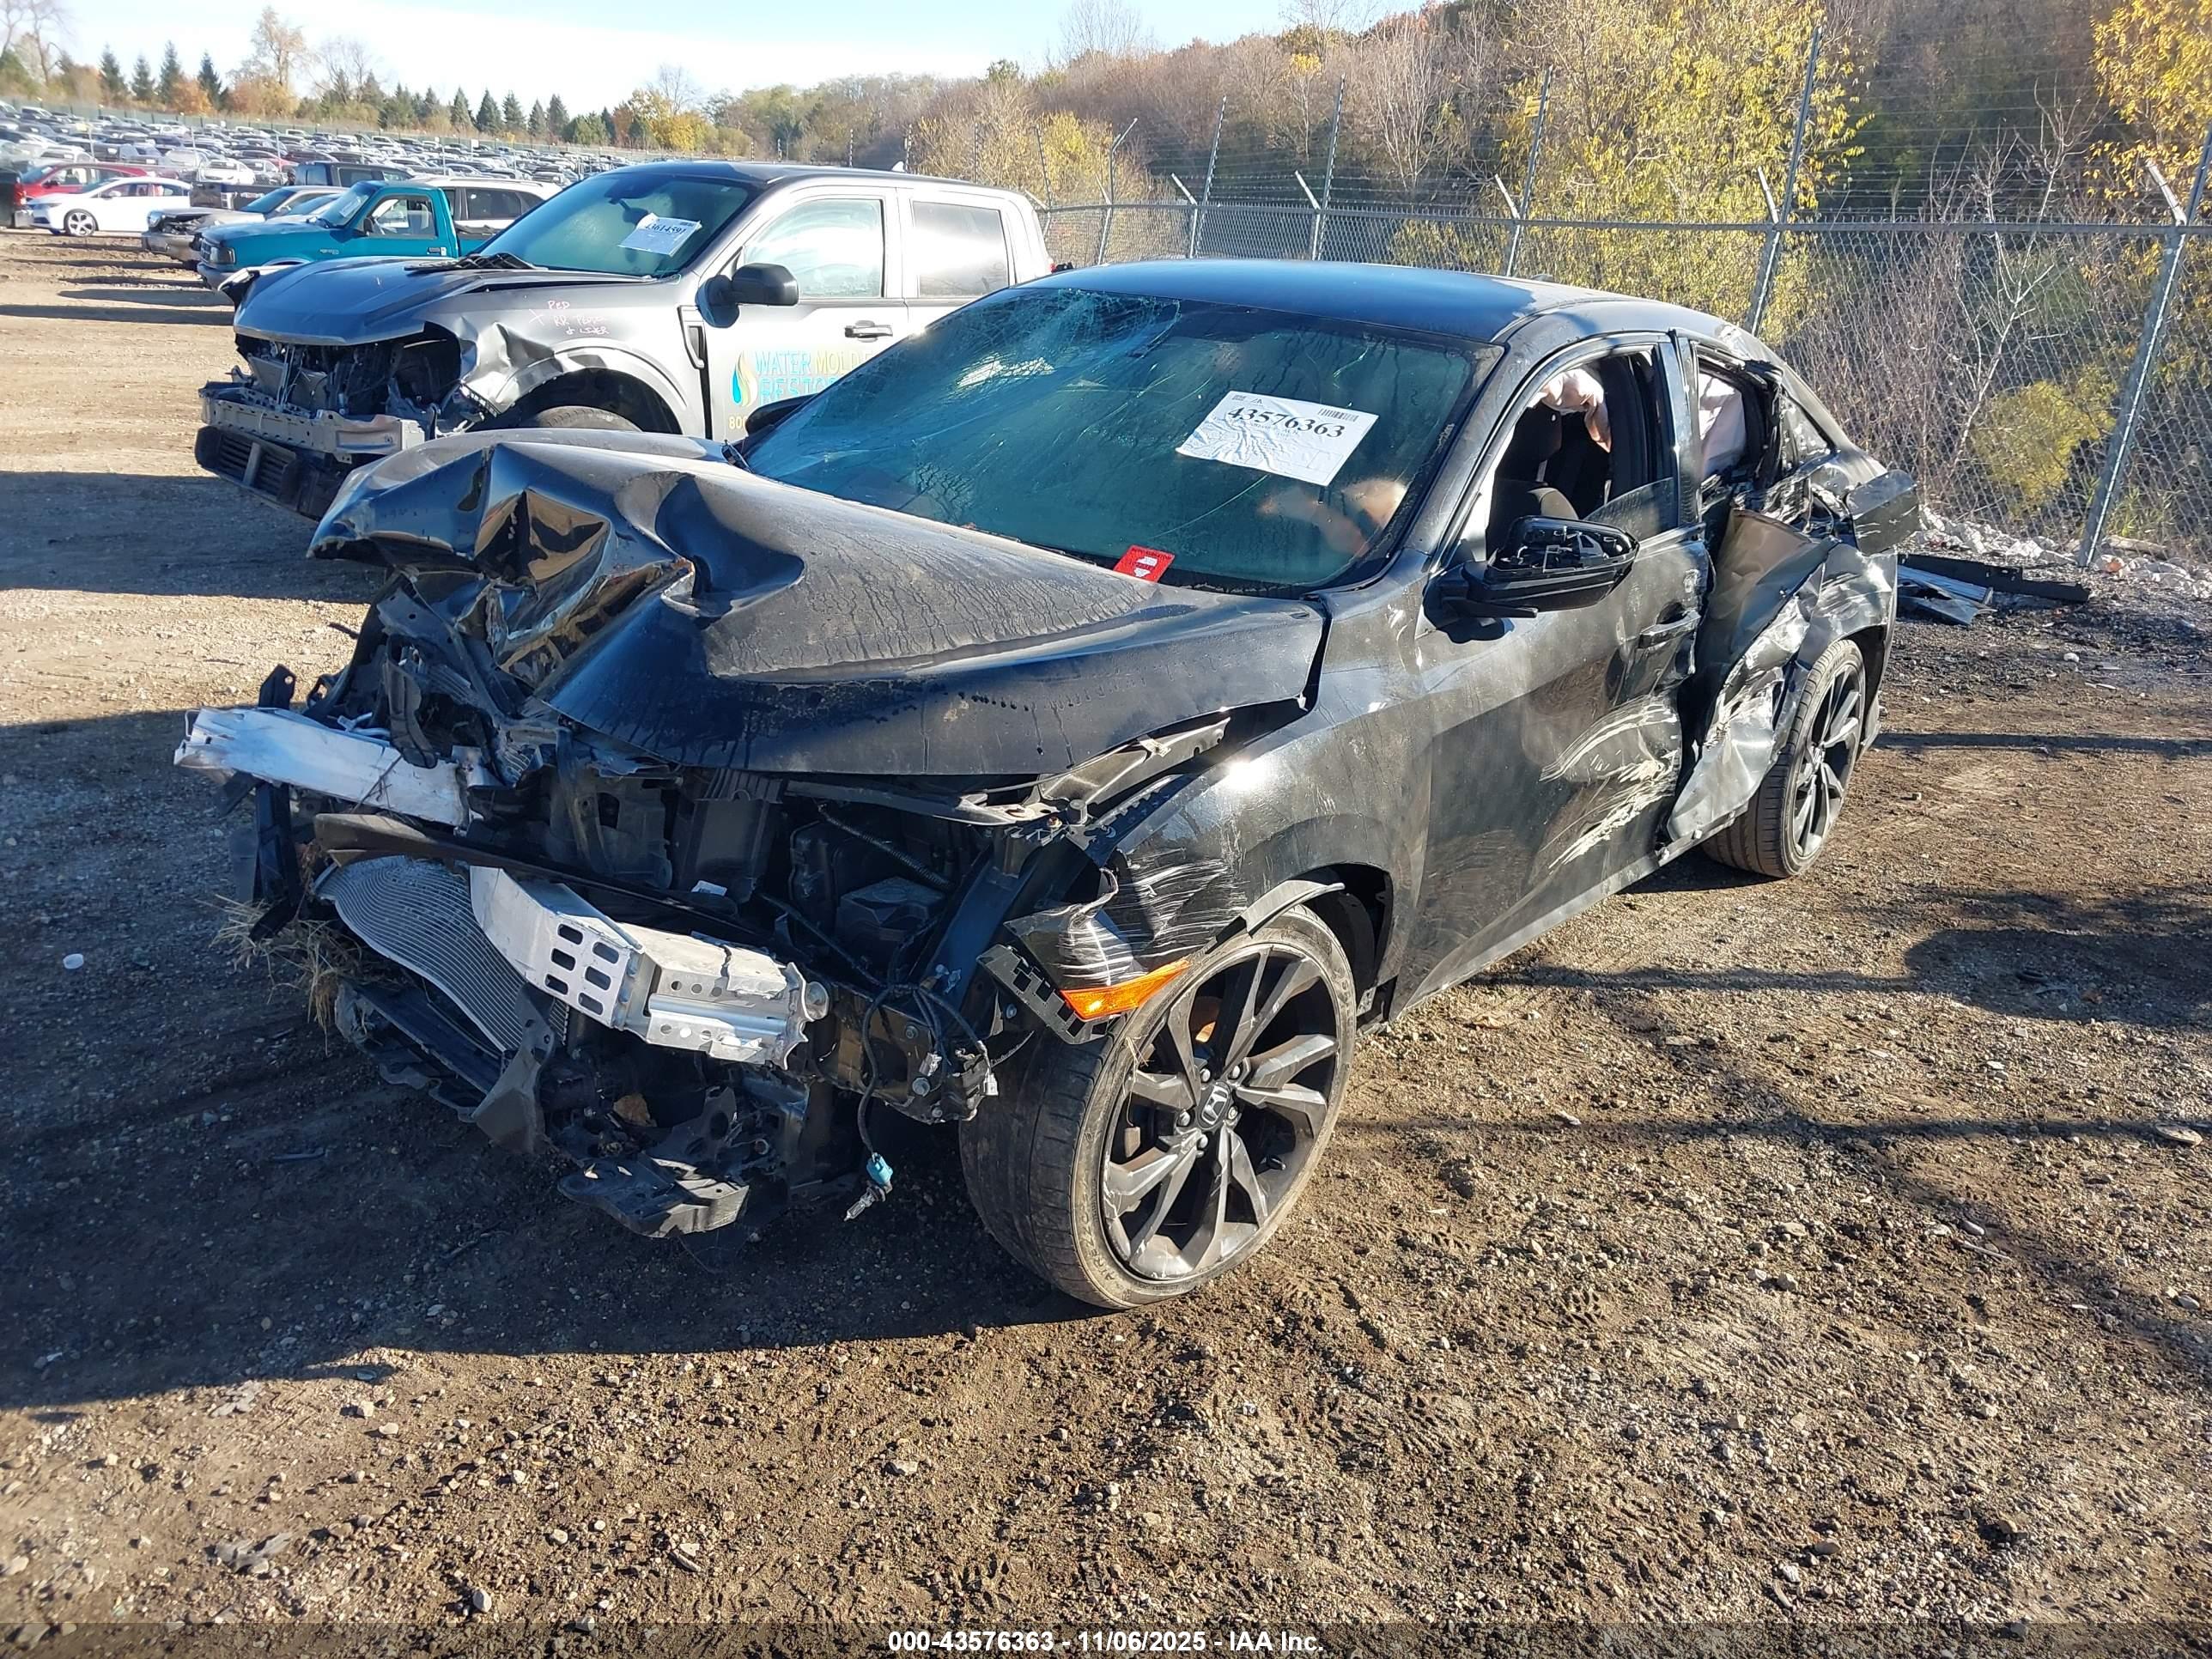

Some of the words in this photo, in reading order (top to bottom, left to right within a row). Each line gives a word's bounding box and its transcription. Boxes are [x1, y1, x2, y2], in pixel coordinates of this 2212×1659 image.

[755, 350, 811, 376] WATER
[815, 350, 860, 376] MOLD
[1227, 406, 1346, 439] 43576363
